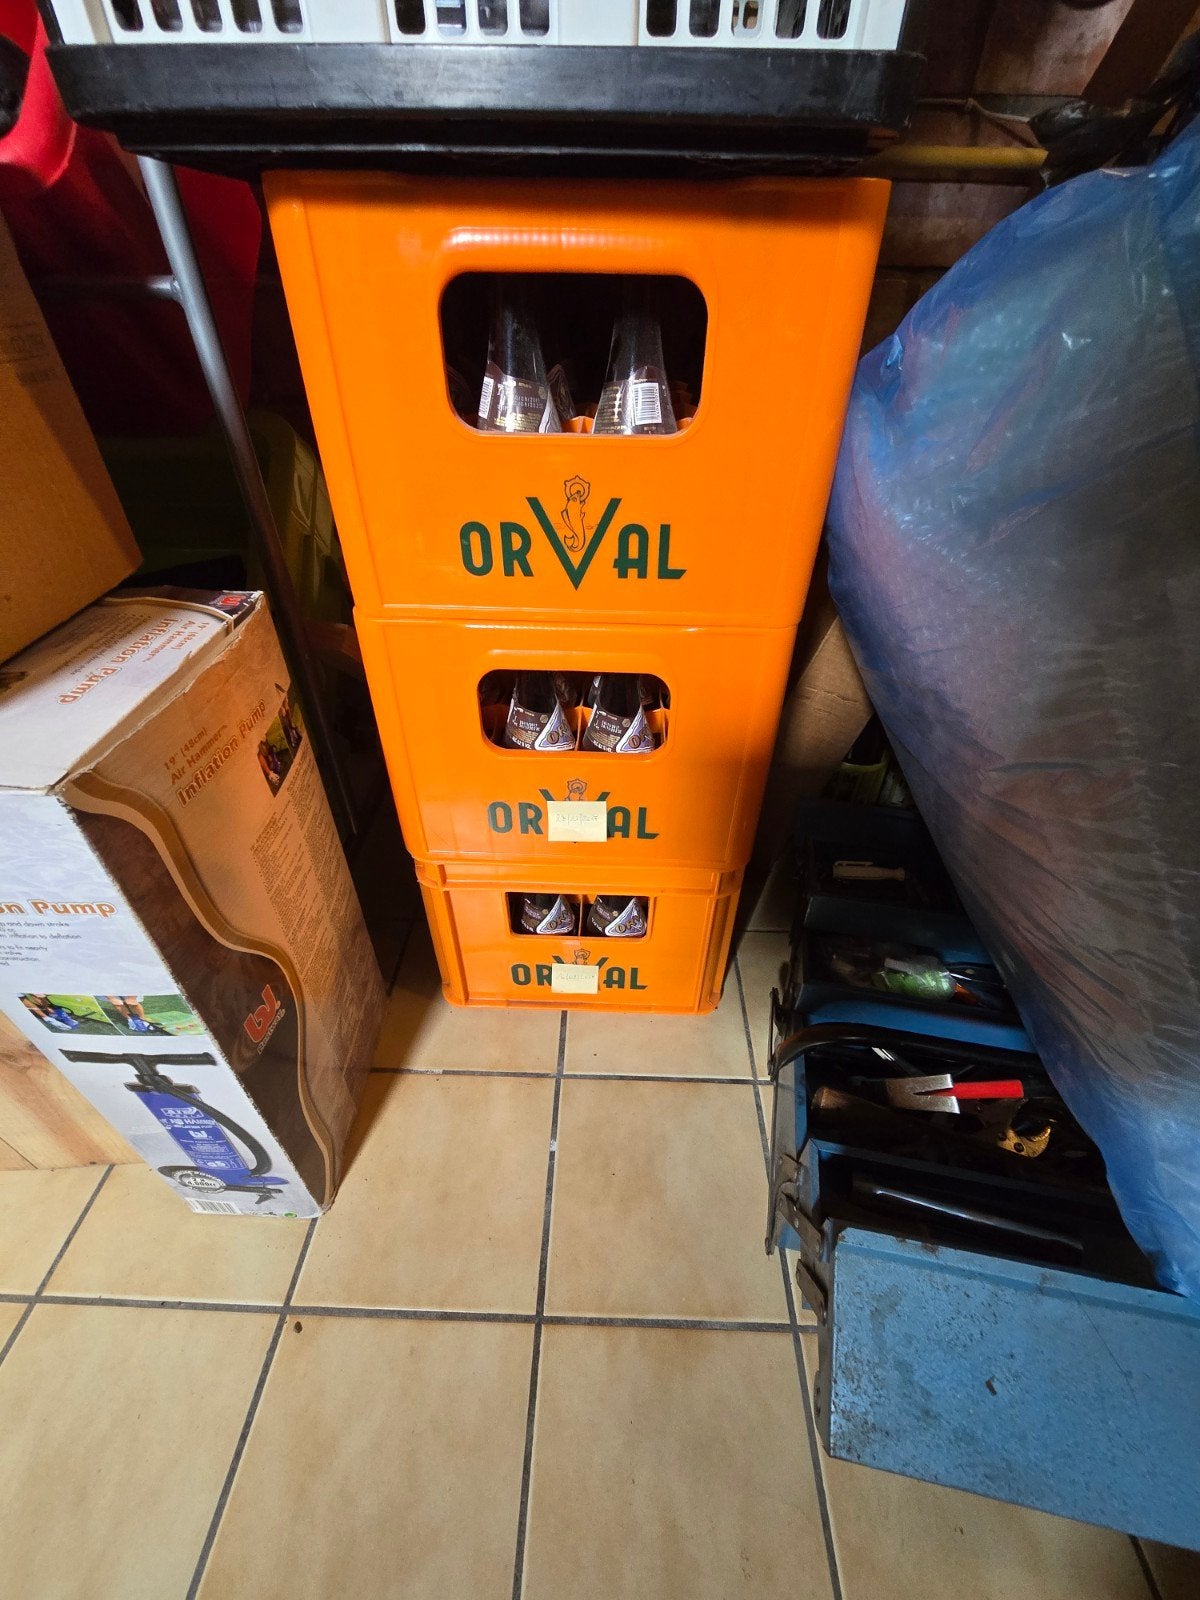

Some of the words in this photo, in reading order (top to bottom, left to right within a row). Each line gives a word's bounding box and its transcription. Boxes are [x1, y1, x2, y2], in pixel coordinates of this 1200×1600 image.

[459, 497, 688, 591] ORVAL
[111, 618, 183, 663] Inflation
[57, 667, 119, 704] Pump
[177, 734, 240, 806] Inflation
[239, 699, 266, 739] Pump
[171, 766, 186, 785] Air
[487, 788, 660, 844] ORAL
[30, 900, 117, 918] Pump
[511, 955, 649, 991] ORAL
